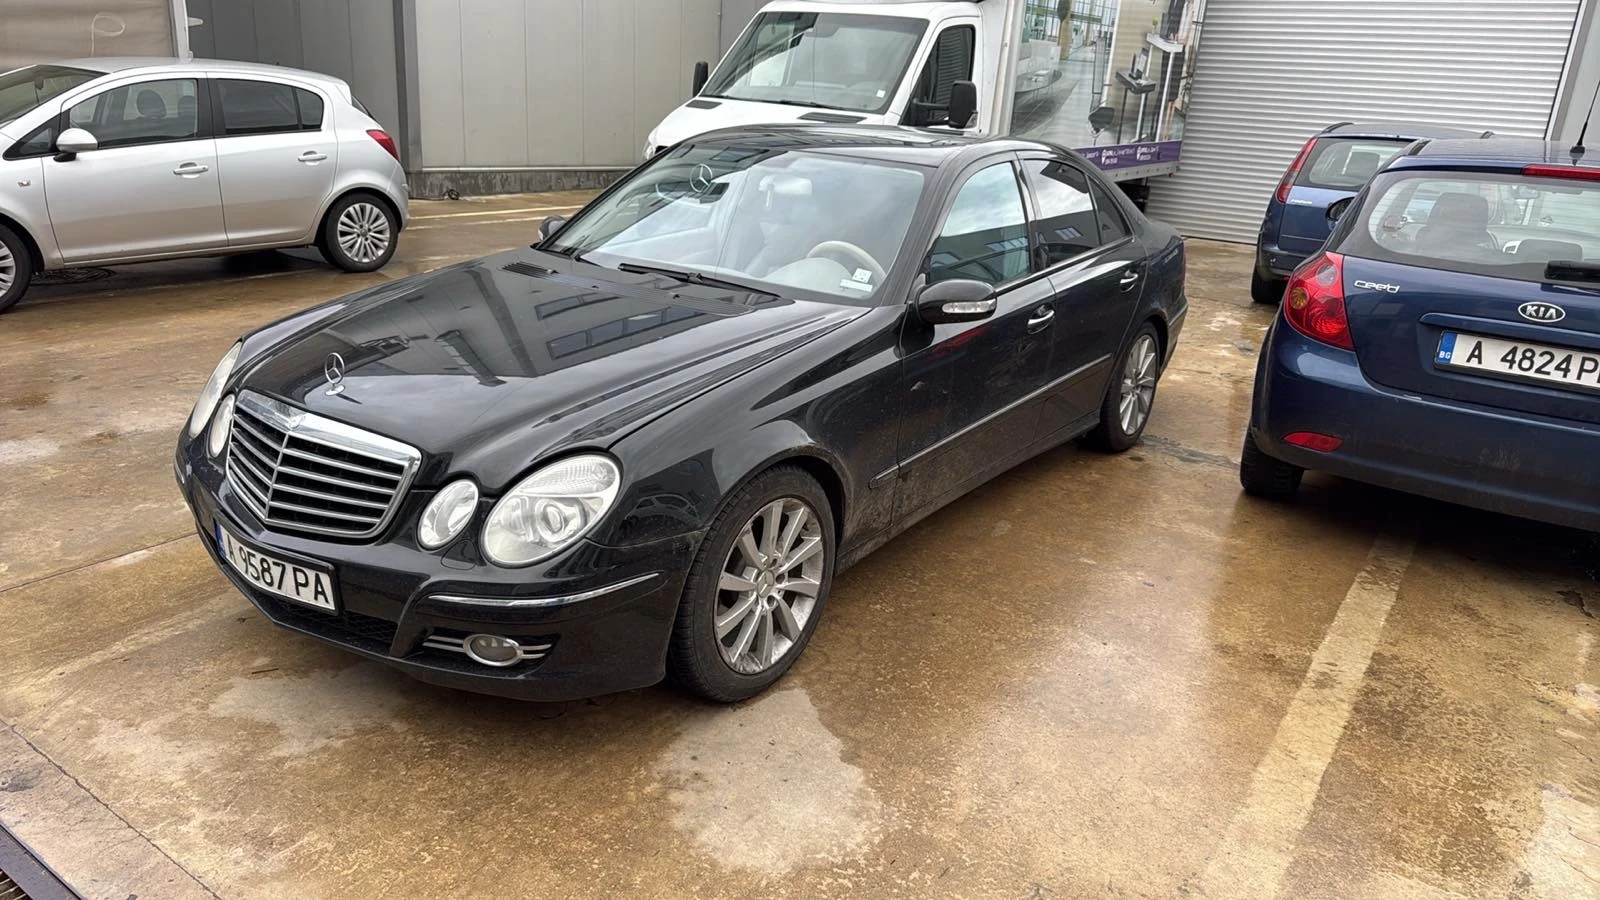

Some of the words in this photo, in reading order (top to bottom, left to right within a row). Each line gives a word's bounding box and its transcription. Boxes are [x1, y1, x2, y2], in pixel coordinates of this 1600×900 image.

[1525, 304, 1557, 319] KIA
[1439, 350, 1451, 359] BG
[1466, 340, 1483, 364] A
[1500, 346, 1573, 378] 4824
[1576, 356, 1600, 384] P
[227, 534, 237, 564] A
[239, 545, 287, 591] 9587
[292, 566, 330, 605] PA
